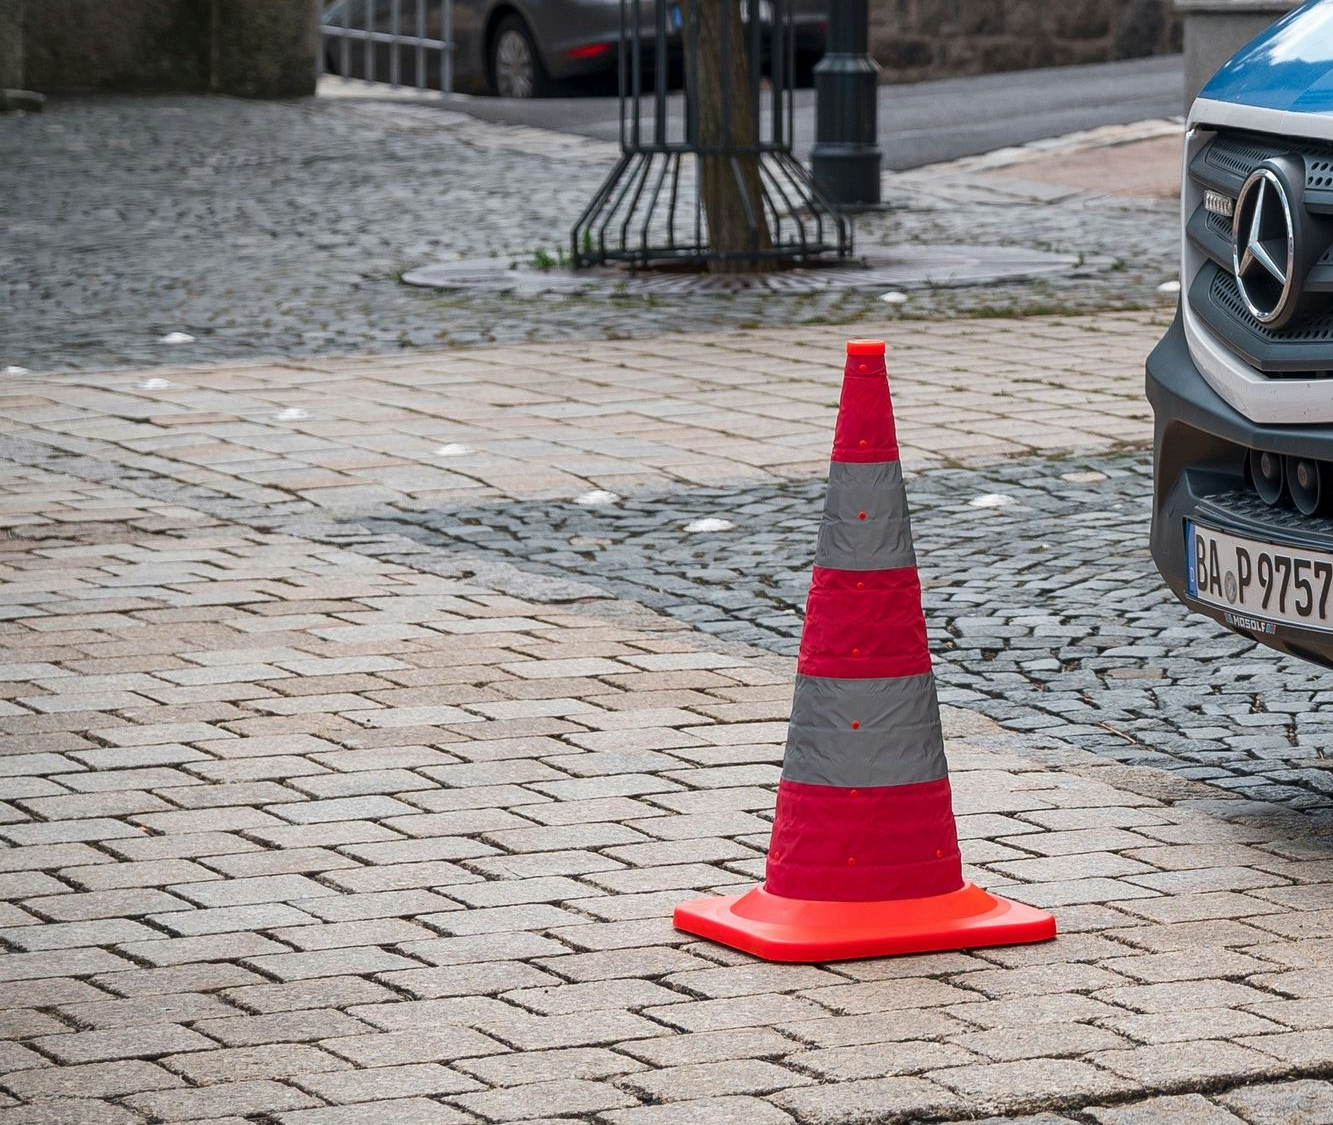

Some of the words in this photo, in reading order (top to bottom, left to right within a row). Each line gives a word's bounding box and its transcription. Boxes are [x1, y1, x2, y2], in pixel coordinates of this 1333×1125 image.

[1196, 534, 1222, 596] BA
[1235, 546, 1252, 604] P
[1257, 552, 1333, 620] 9757
[1232, 615, 1266, 633] MOSOLF
